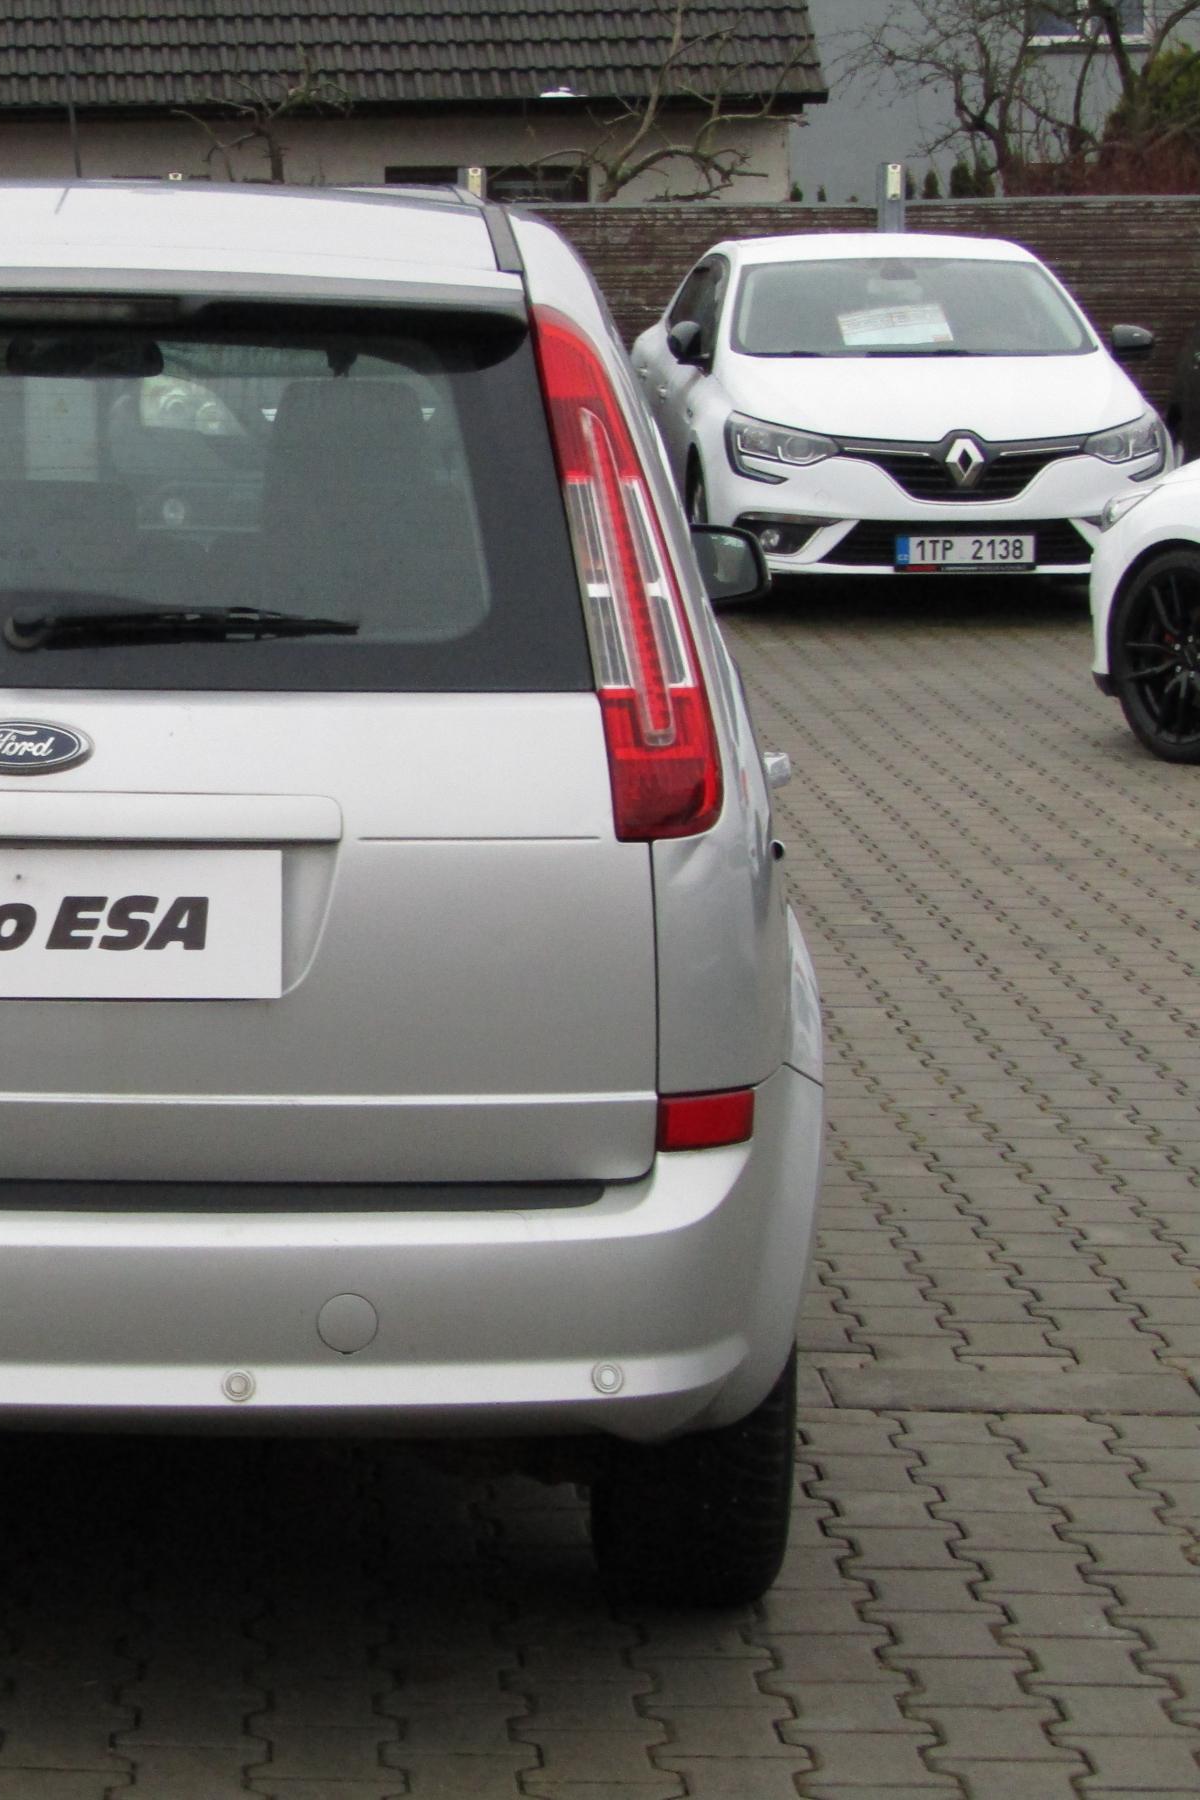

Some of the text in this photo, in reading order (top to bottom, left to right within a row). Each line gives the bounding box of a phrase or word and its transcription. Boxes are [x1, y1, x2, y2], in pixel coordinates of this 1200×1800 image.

[915, 538, 1024, 561] 1TP 2138
[44, 895, 210, 951] ESA
